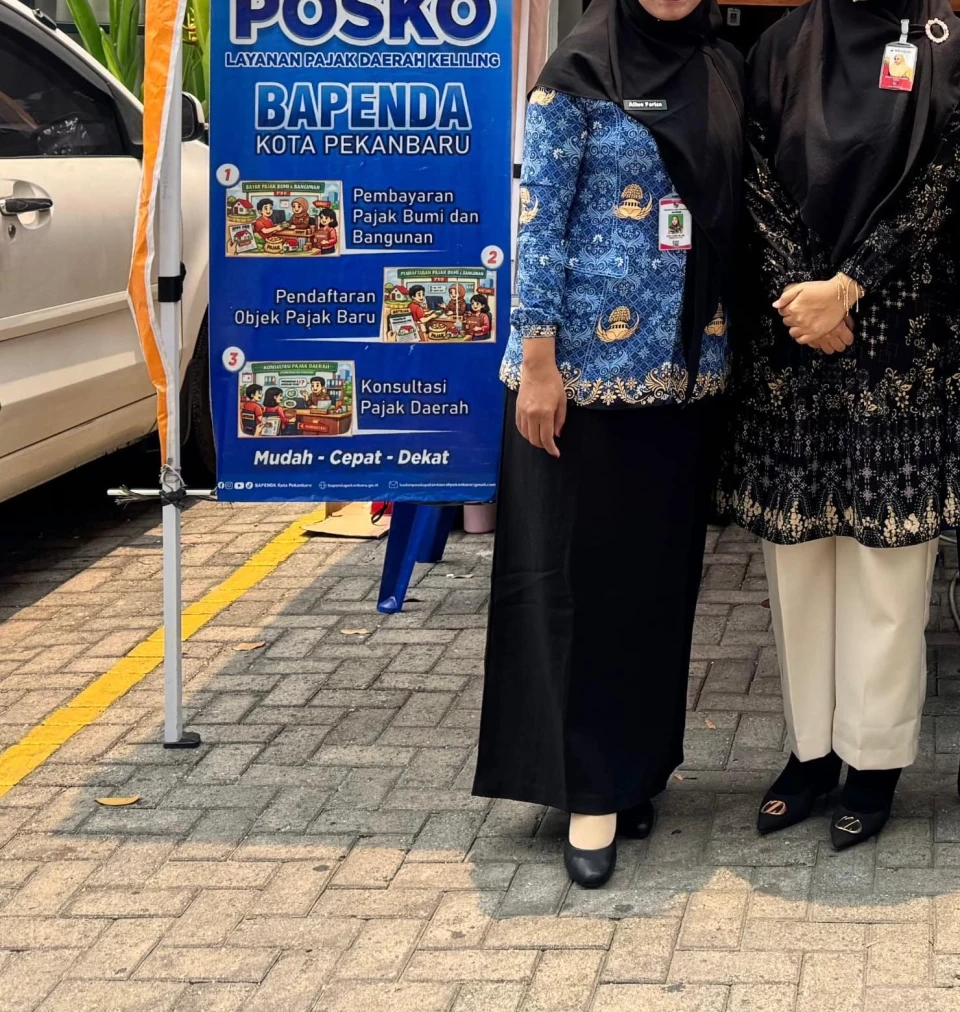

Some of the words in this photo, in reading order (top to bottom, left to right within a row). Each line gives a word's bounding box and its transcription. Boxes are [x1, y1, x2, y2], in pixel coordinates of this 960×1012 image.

[225, 52, 302, 68] LAYANAN
[303, 52, 357, 68] PAJAK
[358, 52, 426, 68] DAERAH
[428, 52, 500, 68] KELILING
[255, 82, 472, 130] BAPENDA
[256, 135, 316, 154] KOTA
[324, 135, 470, 154] PEKANBARU
[223, 168, 231, 181] 1
[353, 188, 454, 206] Pembayaran
[353, 209, 397, 227] Pajak
[403, 209, 444, 223] Bumi
[450, 209, 479, 223] dan
[353, 230, 433, 247] Bangunan
[487, 251, 498, 263] 2
[276, 289, 376, 304] Pendaftaran
[234, 310, 280, 328] Objek
[286, 310, 331, 328] Pajak
[337, 310, 376, 324] Baru
[228, 352, 238, 366] 3
[361, 379, 447, 394] Konsultasi
[360, 400, 405, 418] Pajak
[410, 400, 469, 415] Daerah
[254, 450, 313, 466] Mudah
[329, 450, 381, 468] Cepat
[397, 450, 450, 465] Dekat
